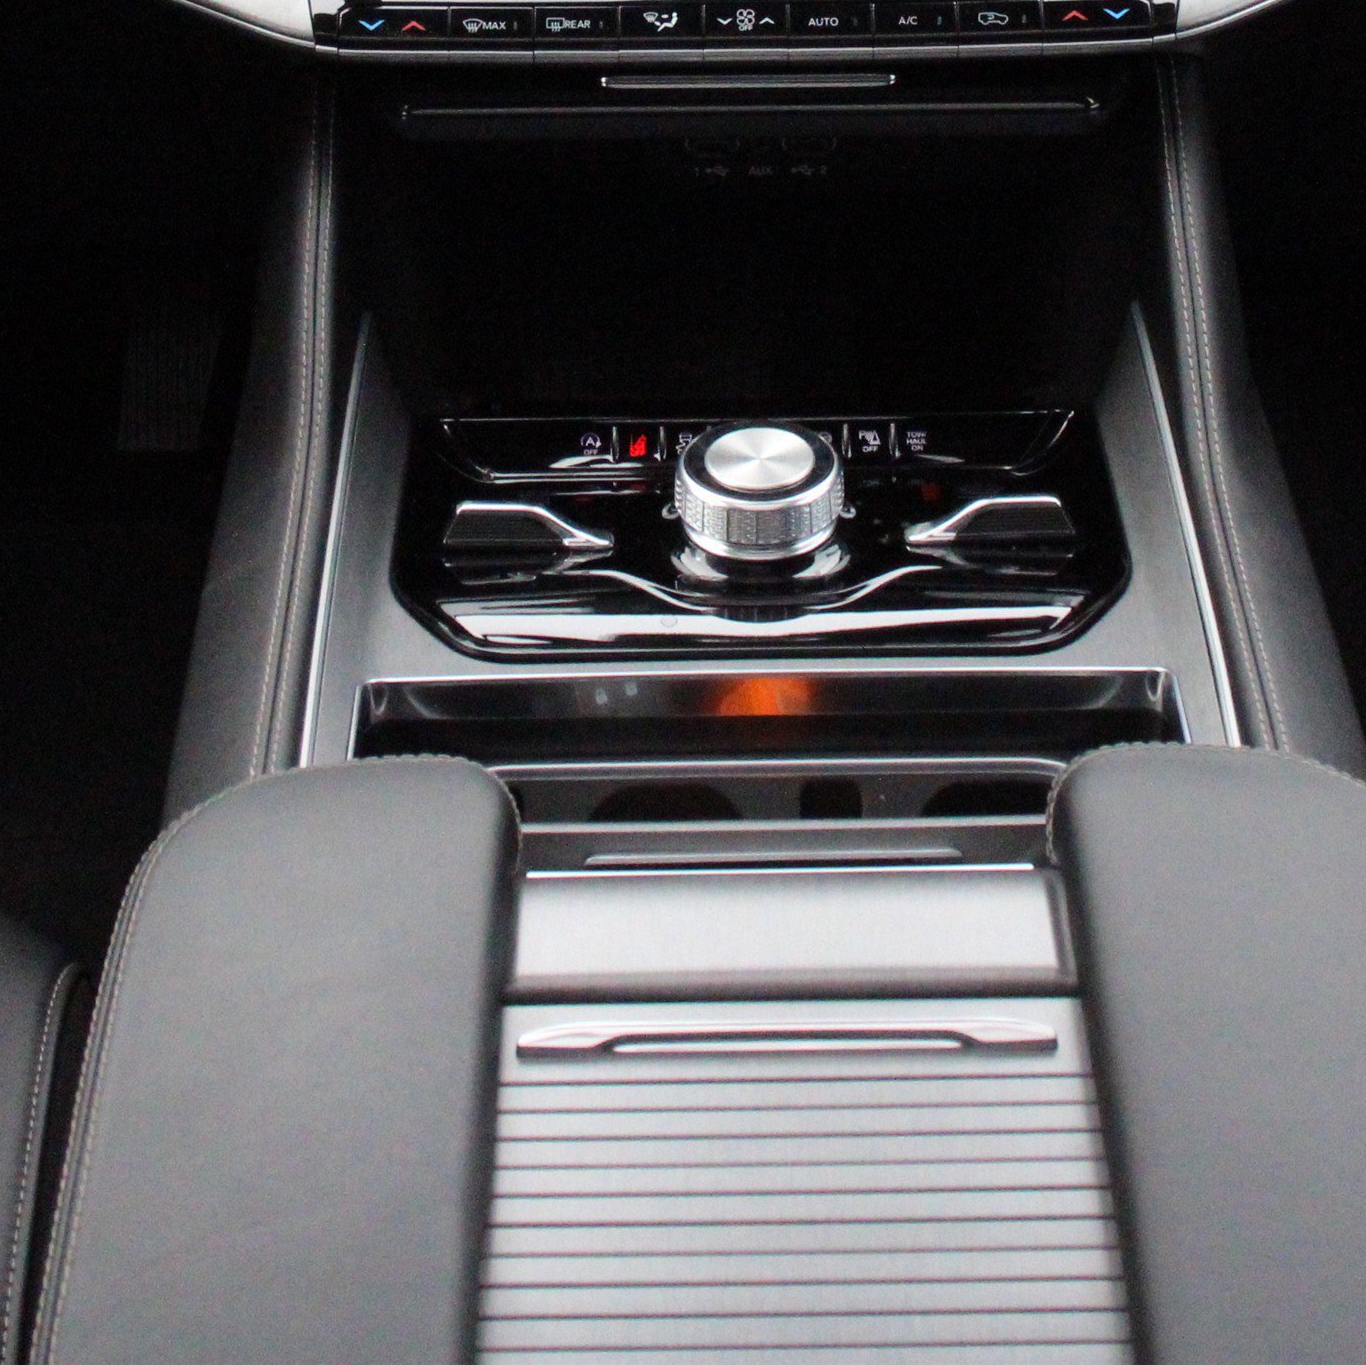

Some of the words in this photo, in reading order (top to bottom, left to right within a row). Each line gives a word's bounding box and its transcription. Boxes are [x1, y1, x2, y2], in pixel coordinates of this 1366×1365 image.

[564, 20, 591, 29] REAR
[808, 17, 839, 27] AUTO
[898, 16, 918, 25] A/C
[482, 21, 507, 30] MAX
[862, 445, 878, 453] OFF
